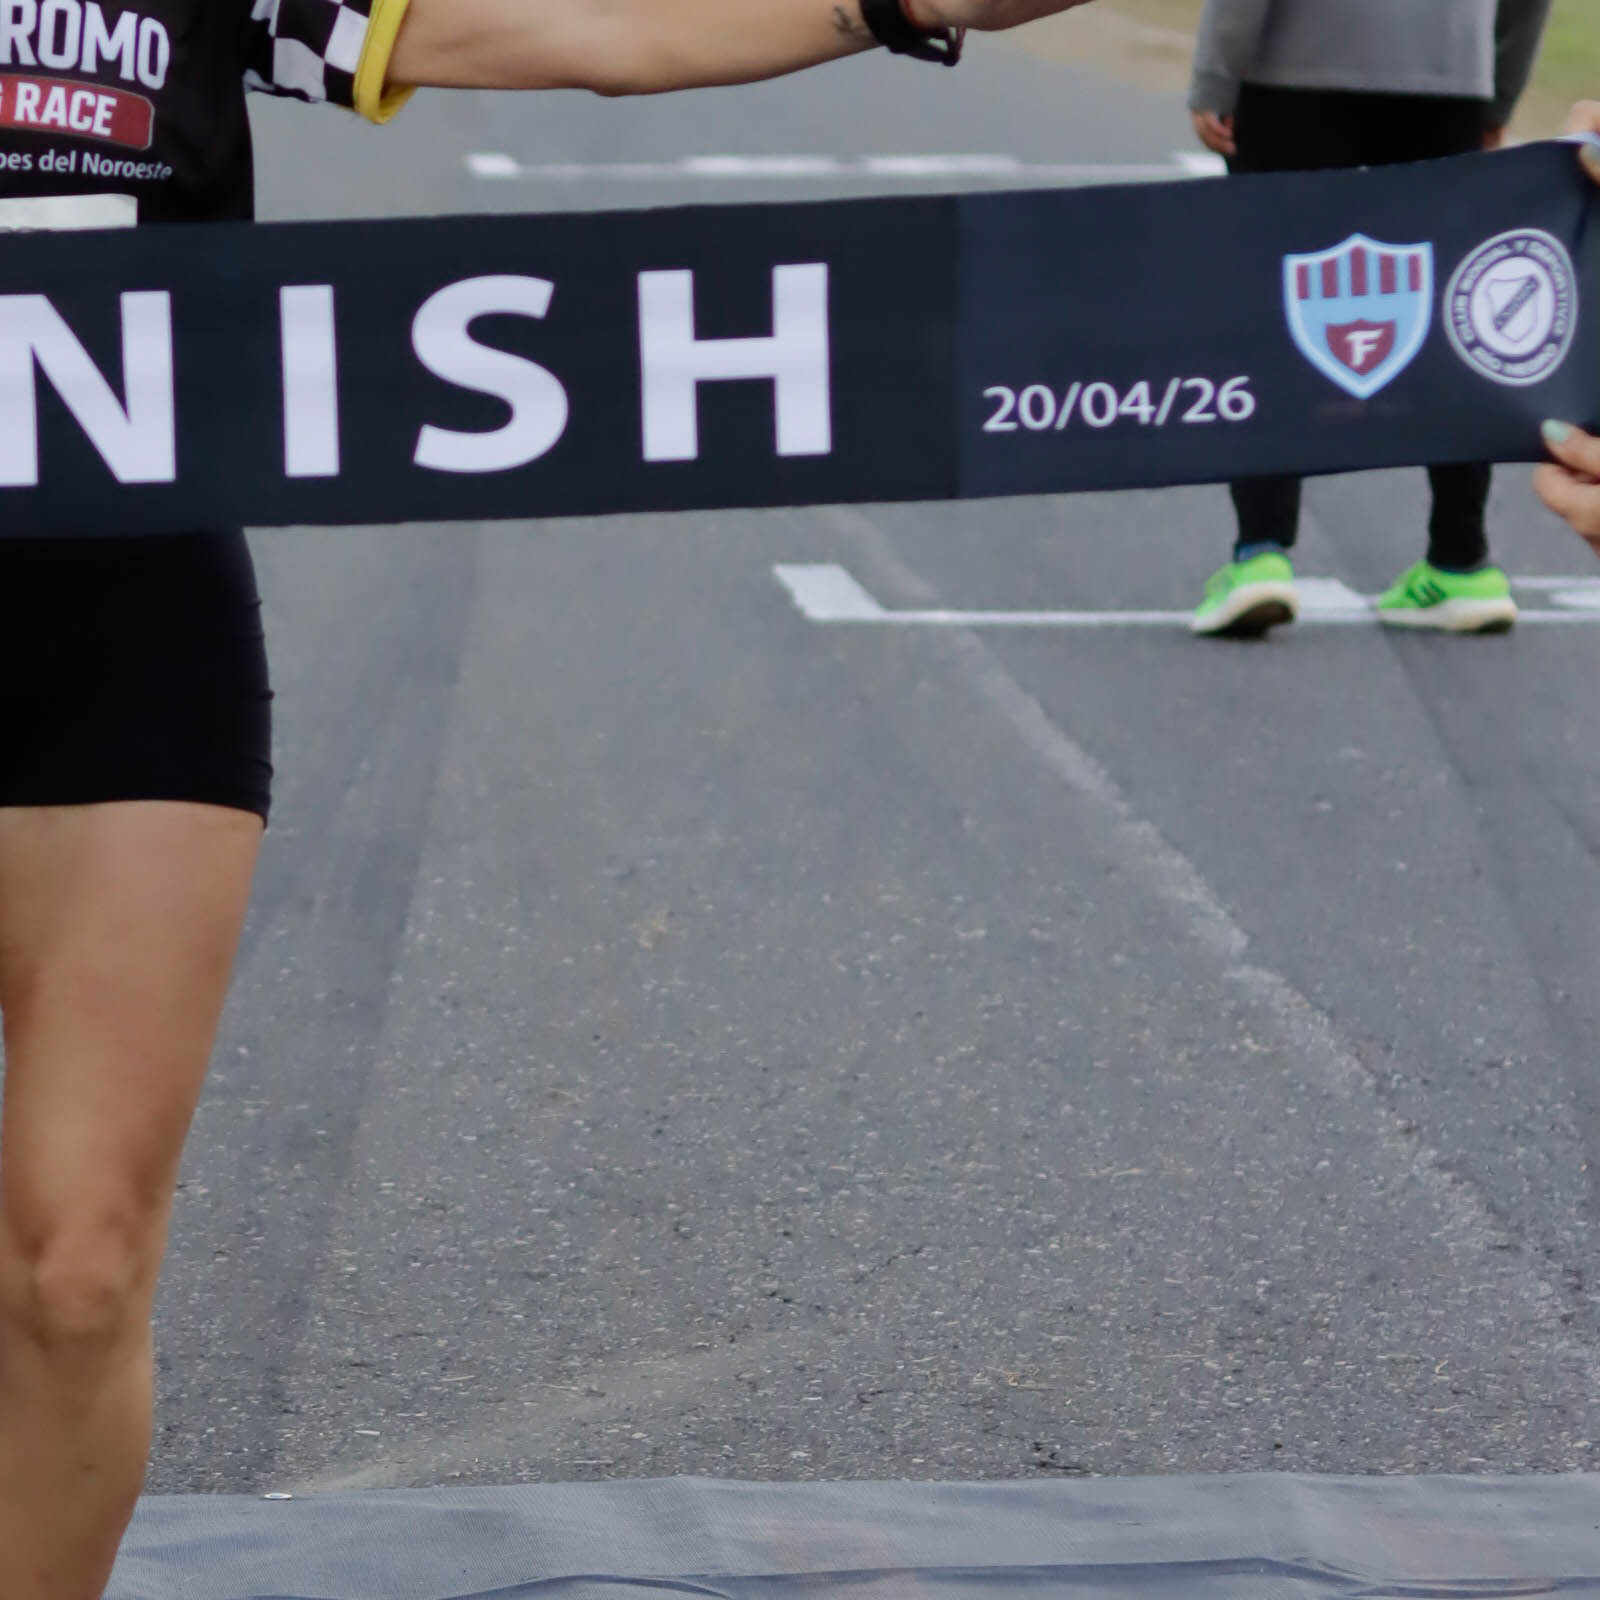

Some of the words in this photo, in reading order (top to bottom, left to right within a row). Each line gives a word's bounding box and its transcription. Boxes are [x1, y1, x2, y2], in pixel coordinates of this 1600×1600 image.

[13, 82, 118, 137] RACE
[38, 148, 76, 175] del
[82, 153, 173, 182] Noroeste
[1345, 327, 1385, 369] F
[982, 375, 1256, 432] 20/04/26
